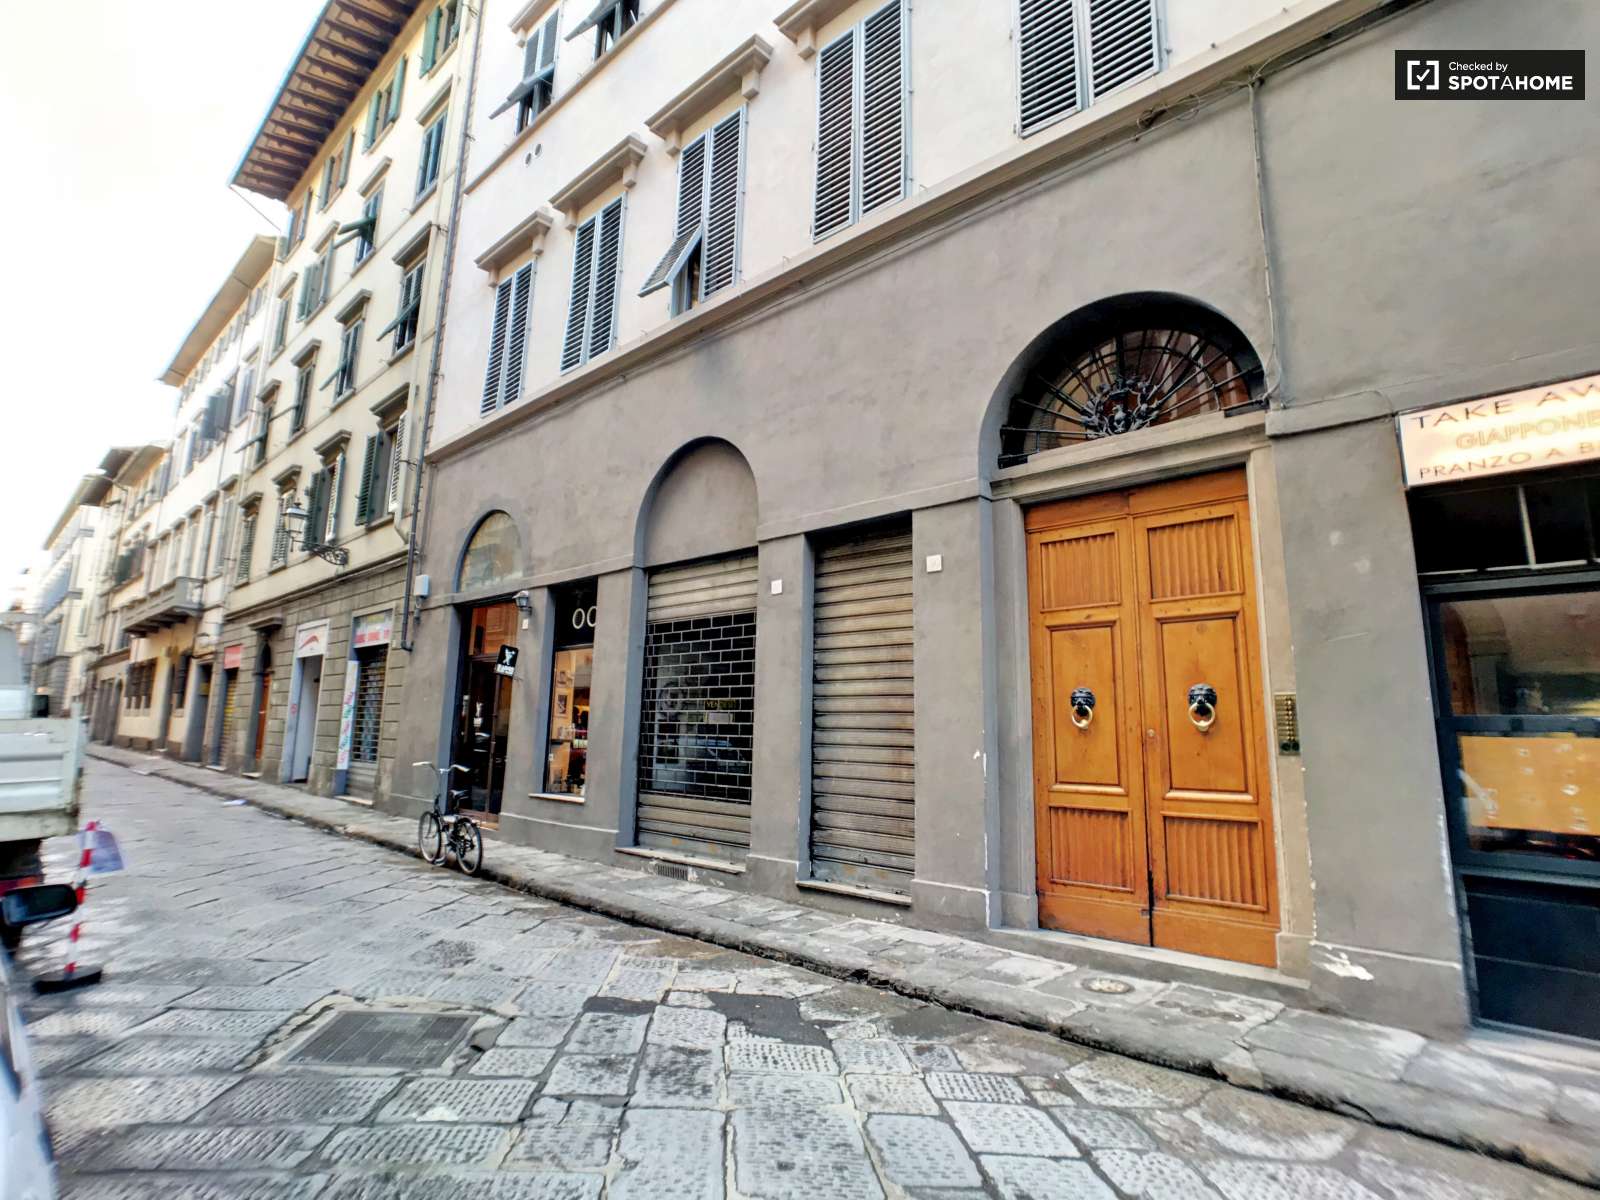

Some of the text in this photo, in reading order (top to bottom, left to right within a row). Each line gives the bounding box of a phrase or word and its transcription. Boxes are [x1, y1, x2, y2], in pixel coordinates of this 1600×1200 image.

[1410, 398, 1514, 429] TAKE
[1419, 442, 1600, 480] PRANZO A B
